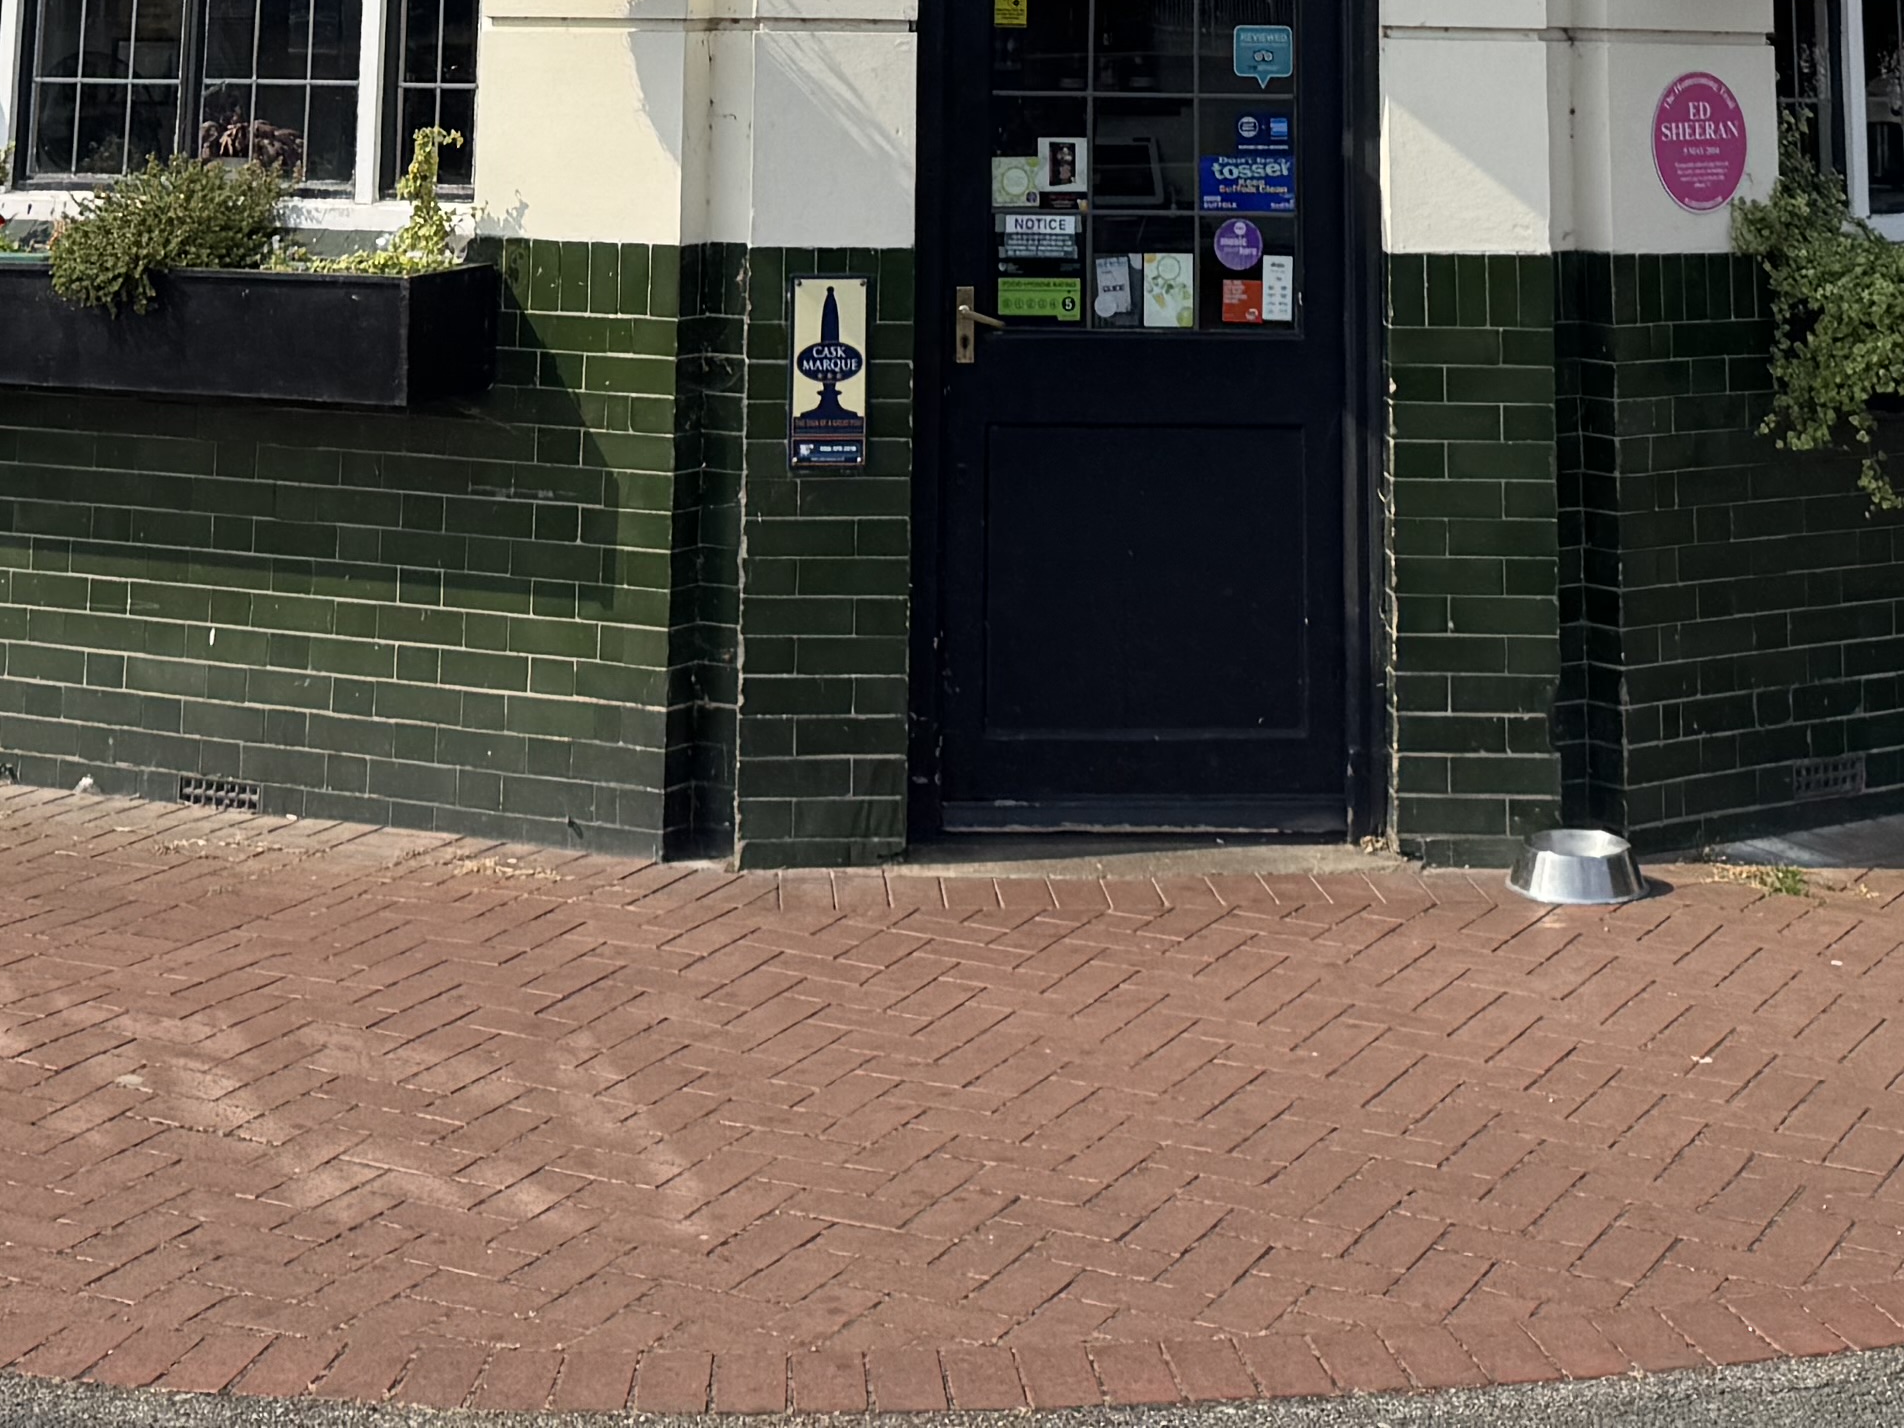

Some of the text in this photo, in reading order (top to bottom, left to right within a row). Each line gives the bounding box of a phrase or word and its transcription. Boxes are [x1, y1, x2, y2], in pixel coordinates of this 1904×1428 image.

[1240, 32, 1288, 42] REVIEWED
[1688, 101, 1711, 120] ED
[1660, 120, 1739, 141] SHEERAN
[1211, 161, 1291, 180] tosser
[1014, 217, 1067, 231] NOTICE
[1065, 298, 1073, 310] 5
[812, 346, 846, 358] CASK
[802, 359, 859, 373] MARQUE
